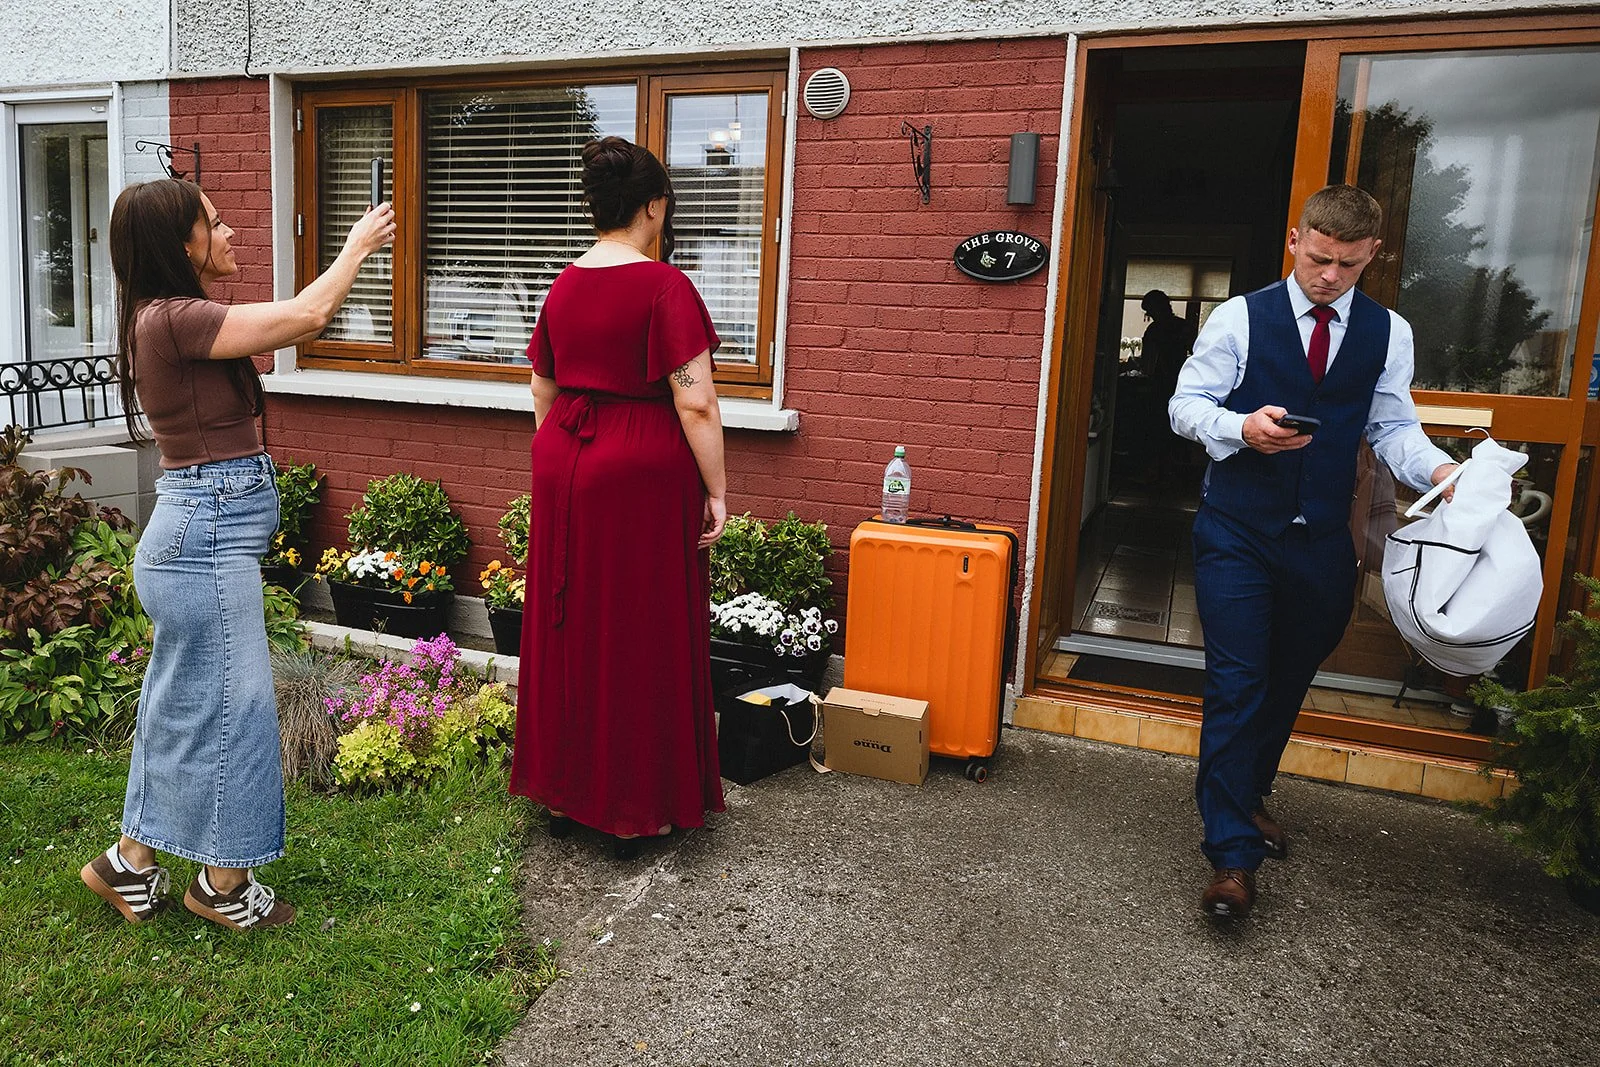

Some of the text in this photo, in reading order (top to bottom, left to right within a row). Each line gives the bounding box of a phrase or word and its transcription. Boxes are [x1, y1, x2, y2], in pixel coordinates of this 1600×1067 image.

[962, 233, 1041, 253] THE GROVE
[1004, 251, 1016, 269] 7
[853, 740, 893, 753] Dune
